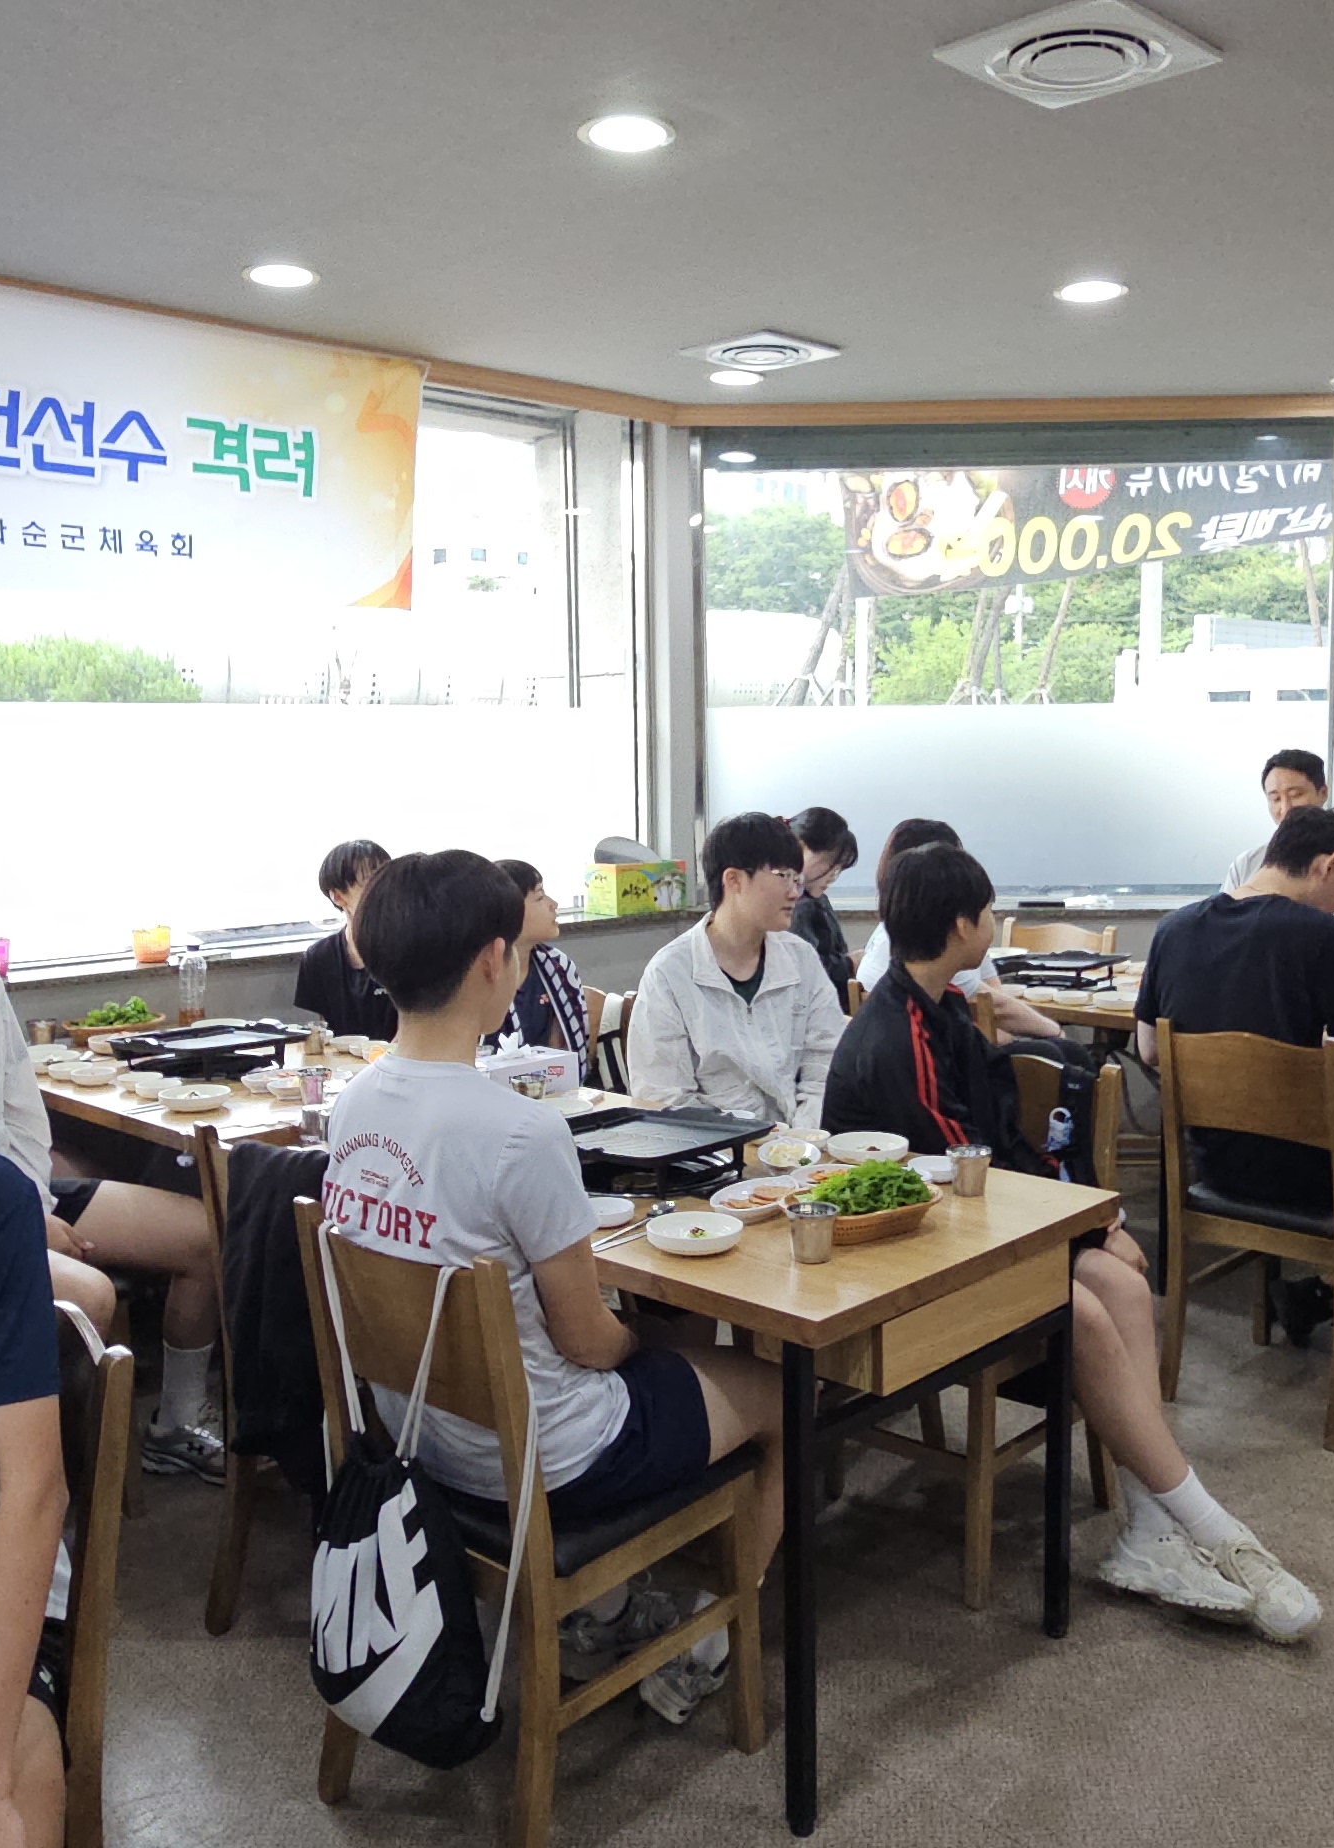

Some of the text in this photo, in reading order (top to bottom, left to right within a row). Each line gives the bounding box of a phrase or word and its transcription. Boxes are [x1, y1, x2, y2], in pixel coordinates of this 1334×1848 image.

[186, 417, 315, 498] 격려
[333, 1132, 379, 1165] WINNING
[381, 1135, 424, 1188] MOMENT
